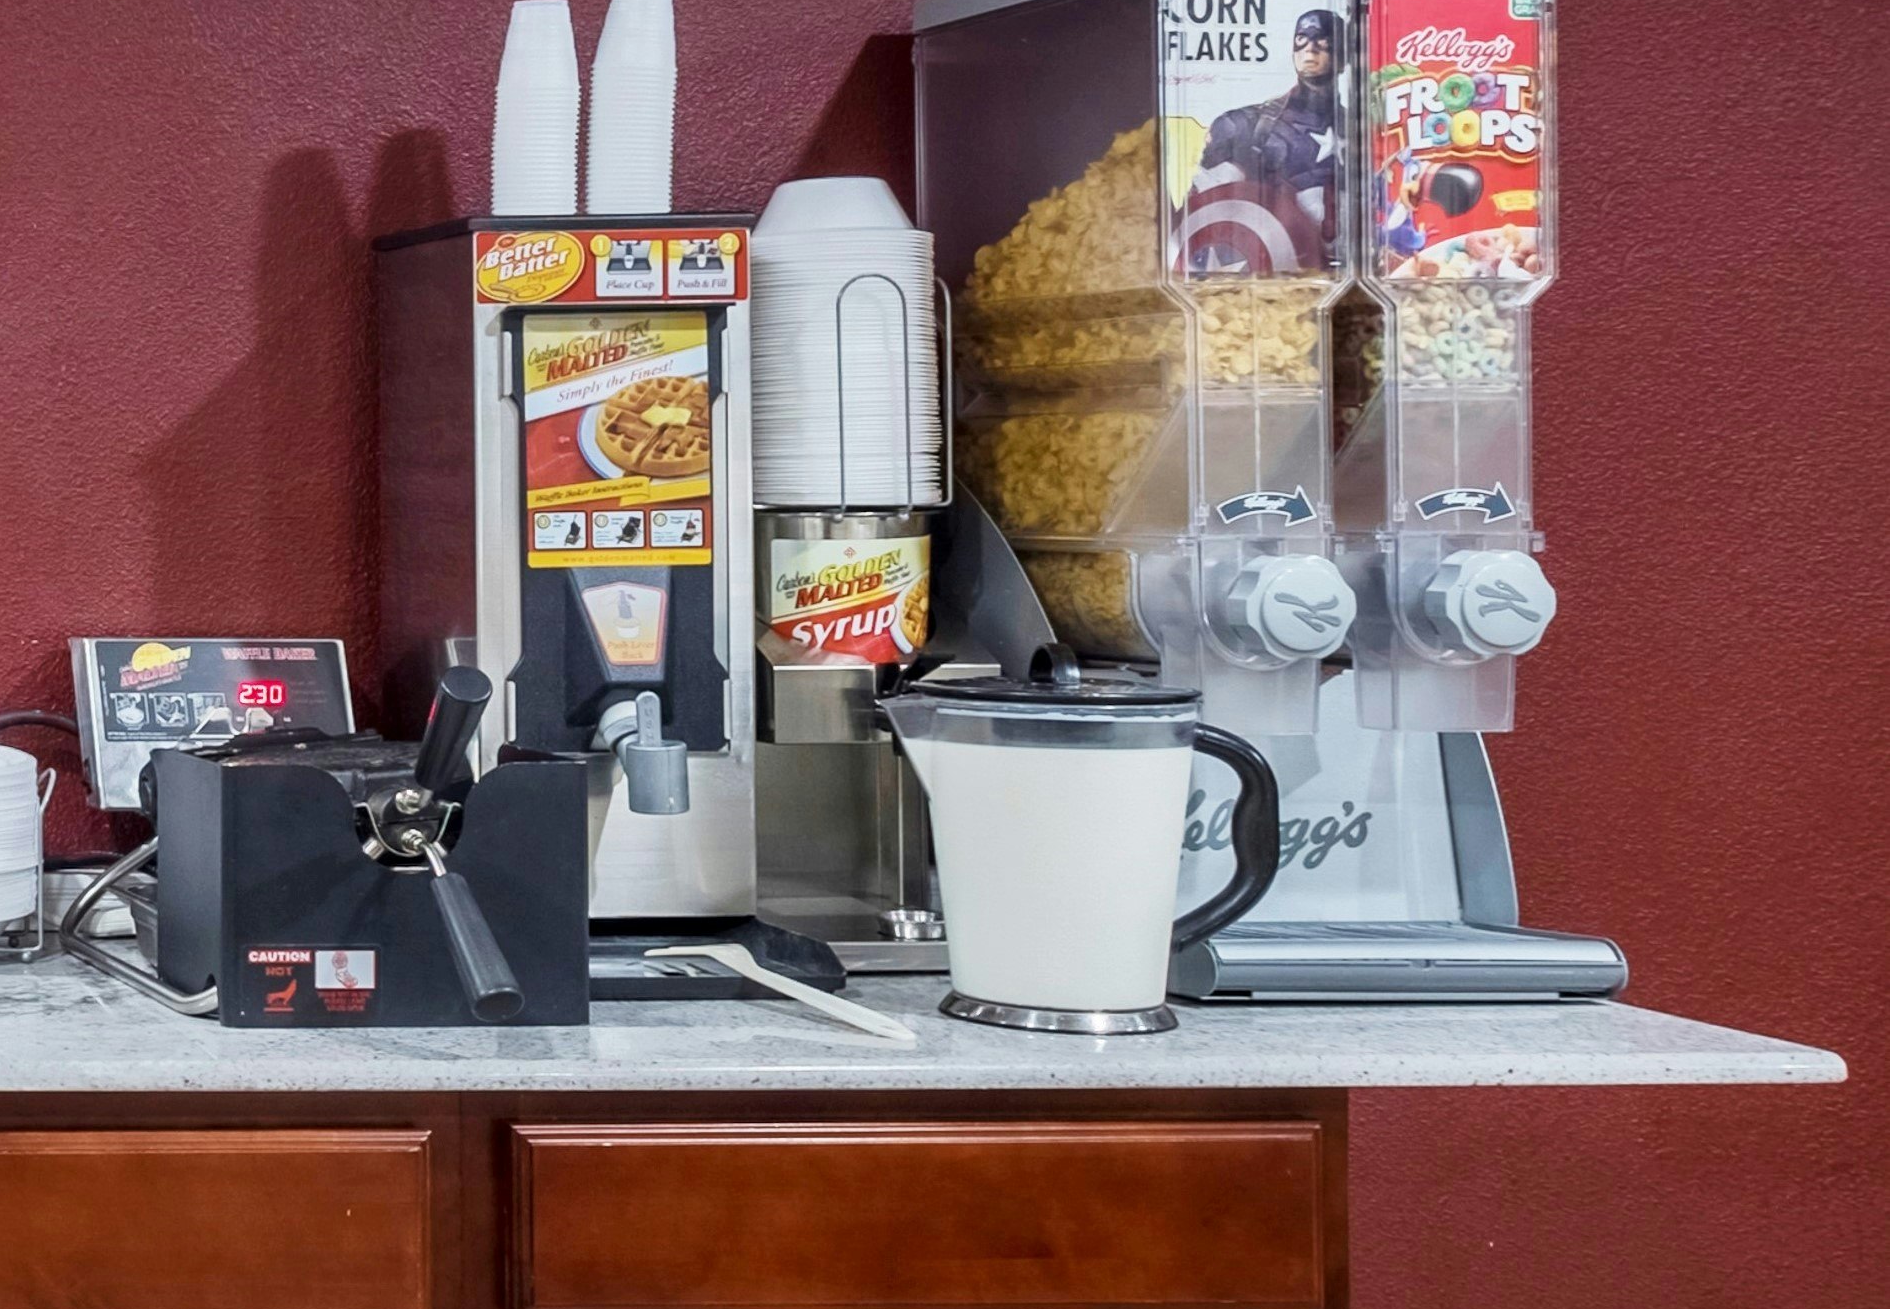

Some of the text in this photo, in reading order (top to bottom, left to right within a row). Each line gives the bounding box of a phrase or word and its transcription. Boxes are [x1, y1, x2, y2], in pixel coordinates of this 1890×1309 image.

[1167, 31, 1269, 62] FLAKES
[1398, 27, 1514, 70] Kellogg's
[1386, 72, 1530, 125] FROOT
[1407, 109, 1538, 154] LOOPS
[485, 237, 557, 269] Better
[724, 238, 733, 250] 2
[634, 279, 655, 293] Cup
[677, 279, 700, 289] Push
[546, 344, 629, 381] MALTED
[557, 359, 674, 403] Simply the Finest!
[818, 549, 901, 587] GOLDEN
[795, 572, 883, 609] MALTED
[792, 604, 897, 651] Syrup
[221, 647, 271, 661] WAFFLE
[239, 683, 283, 704] 230
[1181, 789, 1372, 870] elgg's
[248, 951, 311, 962] CAUTION
[265, 966, 293, 976] HOT
